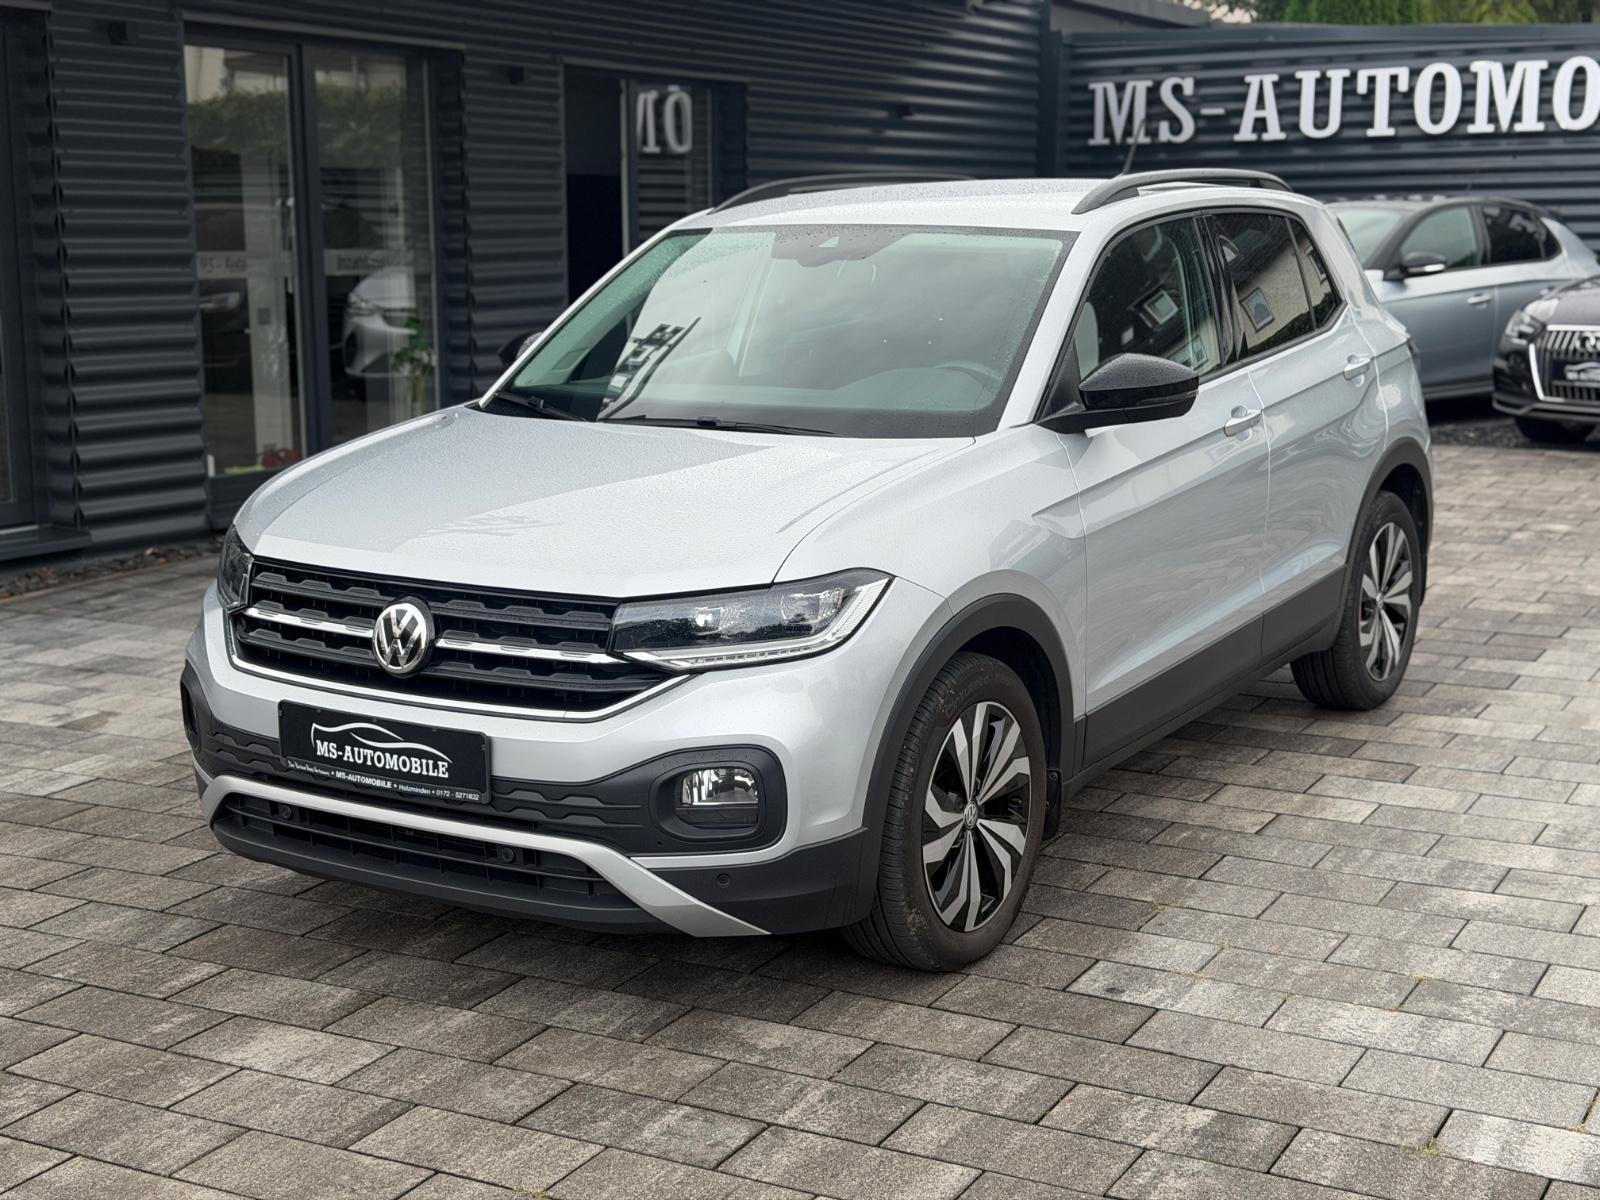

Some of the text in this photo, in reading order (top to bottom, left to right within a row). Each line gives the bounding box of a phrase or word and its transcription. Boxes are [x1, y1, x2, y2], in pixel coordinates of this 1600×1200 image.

[1088, 56, 1600, 146] MS-AUTOMO
[315, 740, 449, 778] MS-AUTOMOBILE
[336, 770, 392, 788] MS-AUTOMOBILE
[436, 789, 451, 798] 0172
